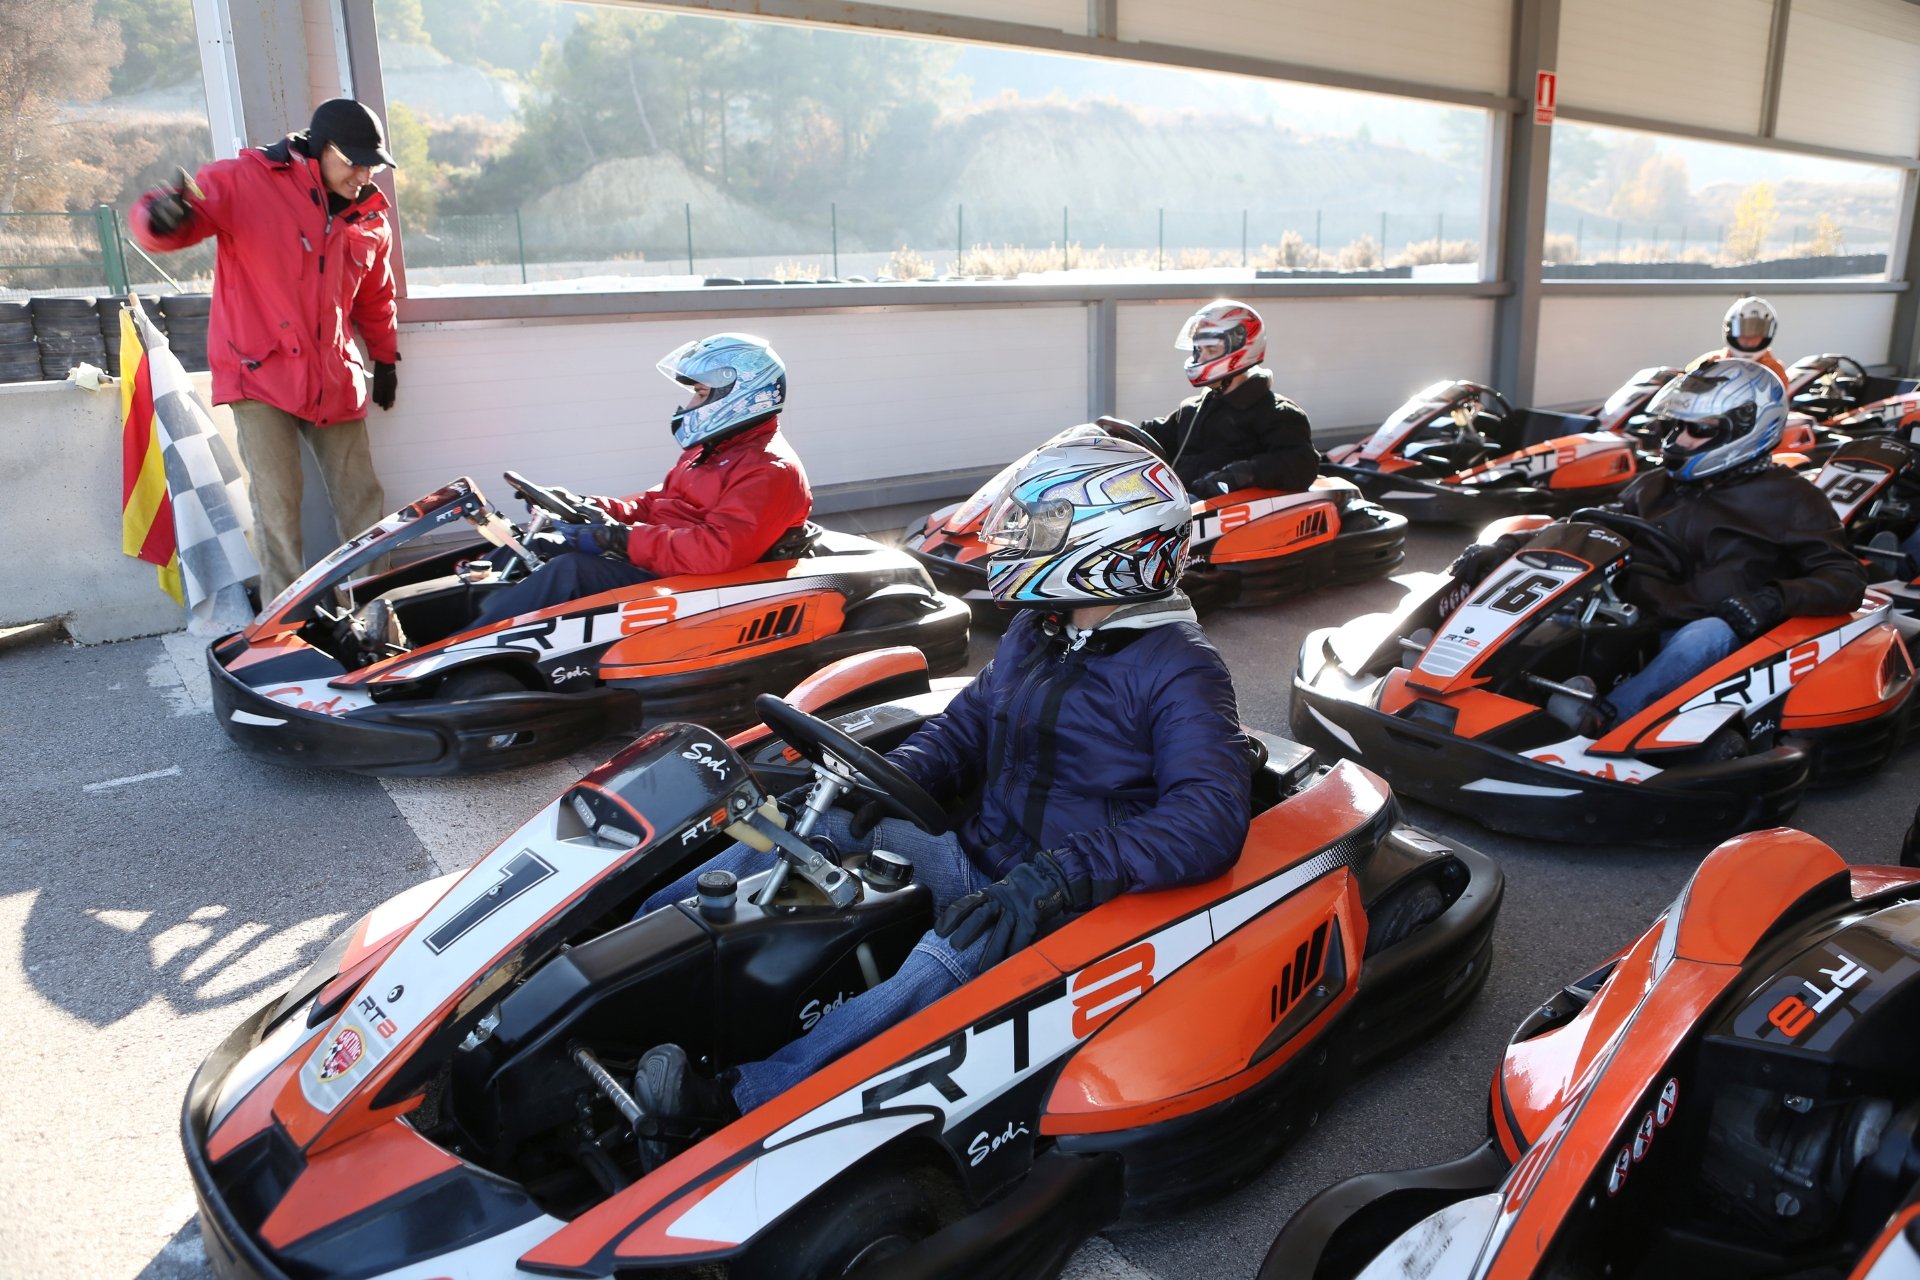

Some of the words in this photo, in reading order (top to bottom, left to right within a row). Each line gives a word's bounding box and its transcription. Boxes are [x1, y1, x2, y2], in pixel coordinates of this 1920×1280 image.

[1510, 447, 1577, 471] RT8
[1821, 472, 1878, 505] 19
[436, 505, 462, 522] RT8
[1191, 504, 1251, 539] T8
[1604, 559, 1624, 575] RT8
[1467, 567, 1564, 615] 16
[497, 597, 678, 650] RT8
[1442, 633, 1481, 649] RT8
[551, 666, 592, 684] Sodi
[1714, 640, 1820, 704] RT8
[1751, 719, 1776, 740] Sodi
[682, 742, 731, 781] Sodi
[681, 806, 729, 847] RT8
[422, 847, 560, 957] 1
[799, 991, 855, 1031] Sodi
[1767, 953, 1869, 1038] RT8
[358, 994, 398, 1040] RT8
[862, 942, 1156, 1115] RT8
[967, 1121, 1030, 1168] Sodi
